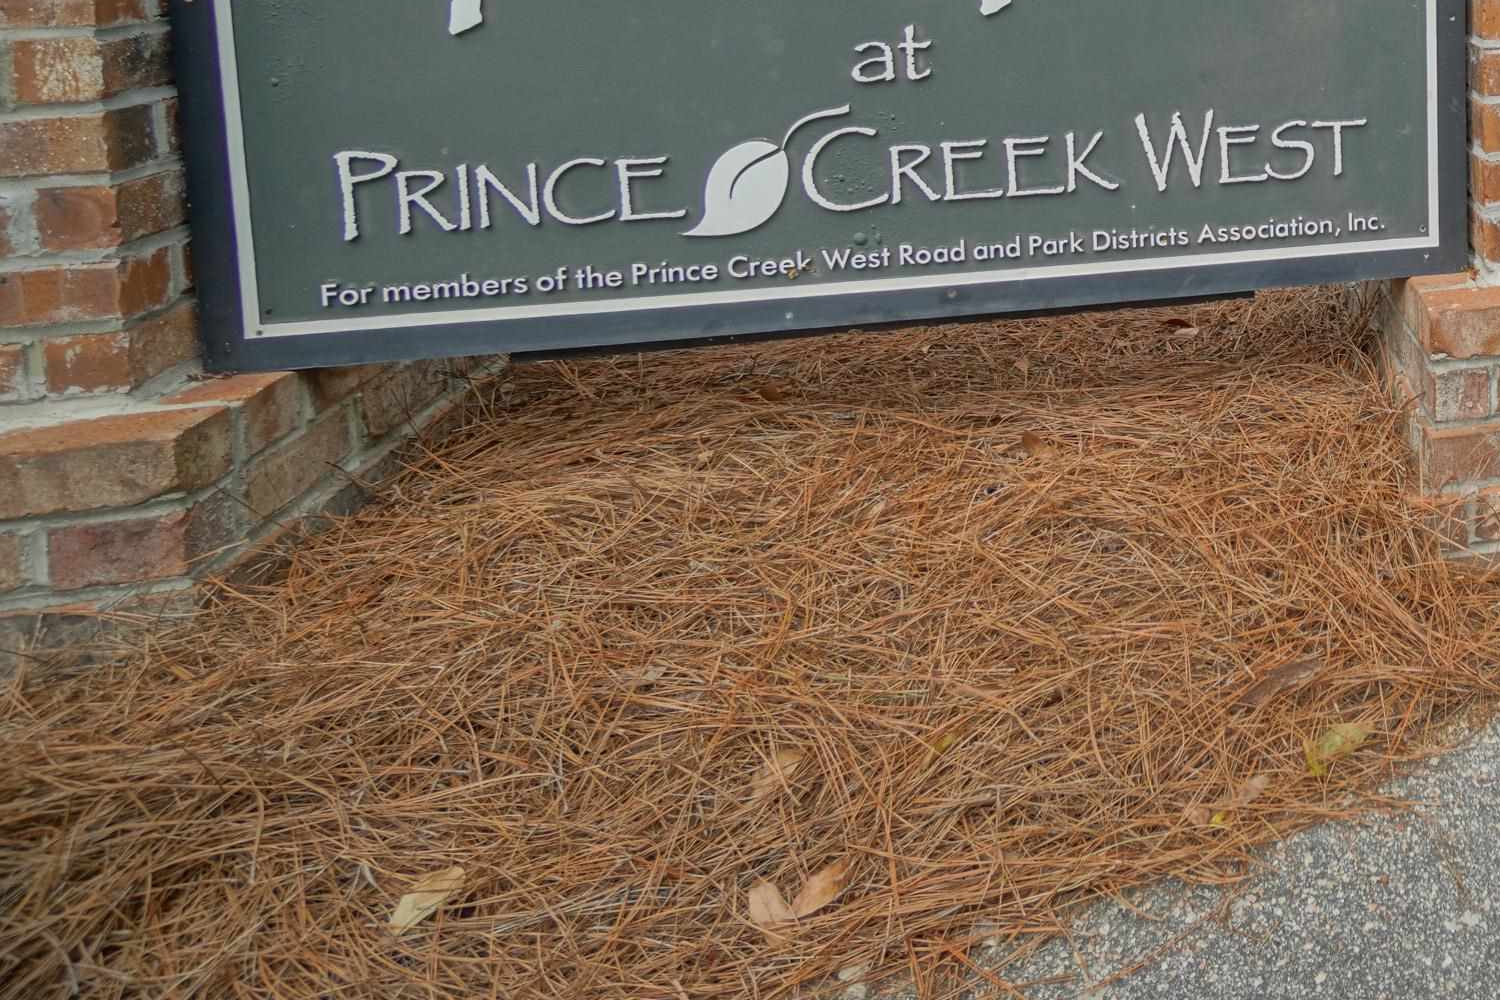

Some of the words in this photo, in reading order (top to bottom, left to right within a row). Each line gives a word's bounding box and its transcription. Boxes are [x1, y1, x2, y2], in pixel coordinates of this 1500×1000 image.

[851, 23, 932, 82] at
[334, 150, 687, 241] PRINCE
[801, 126, 1120, 211] CREEK
[1134, 109, 1368, 192] WEST
[320, 282, 372, 306] For
[383, 275, 528, 302] members
[535, 266, 567, 292] of
[573, 265, 623, 289] the
[631, 262, 718, 285] Prince
[727, 250, 812, 278] Creek
[821, 246, 891, 270] West
[898, 240, 965, 266] Road
[973, 236, 1021, 260] and
[1028, 231, 1084, 256] Park
[1092, 226, 1189, 252] Districts
[1197, 219, 1342, 244] Association,
[1348, 211, 1385, 233] Inc.
